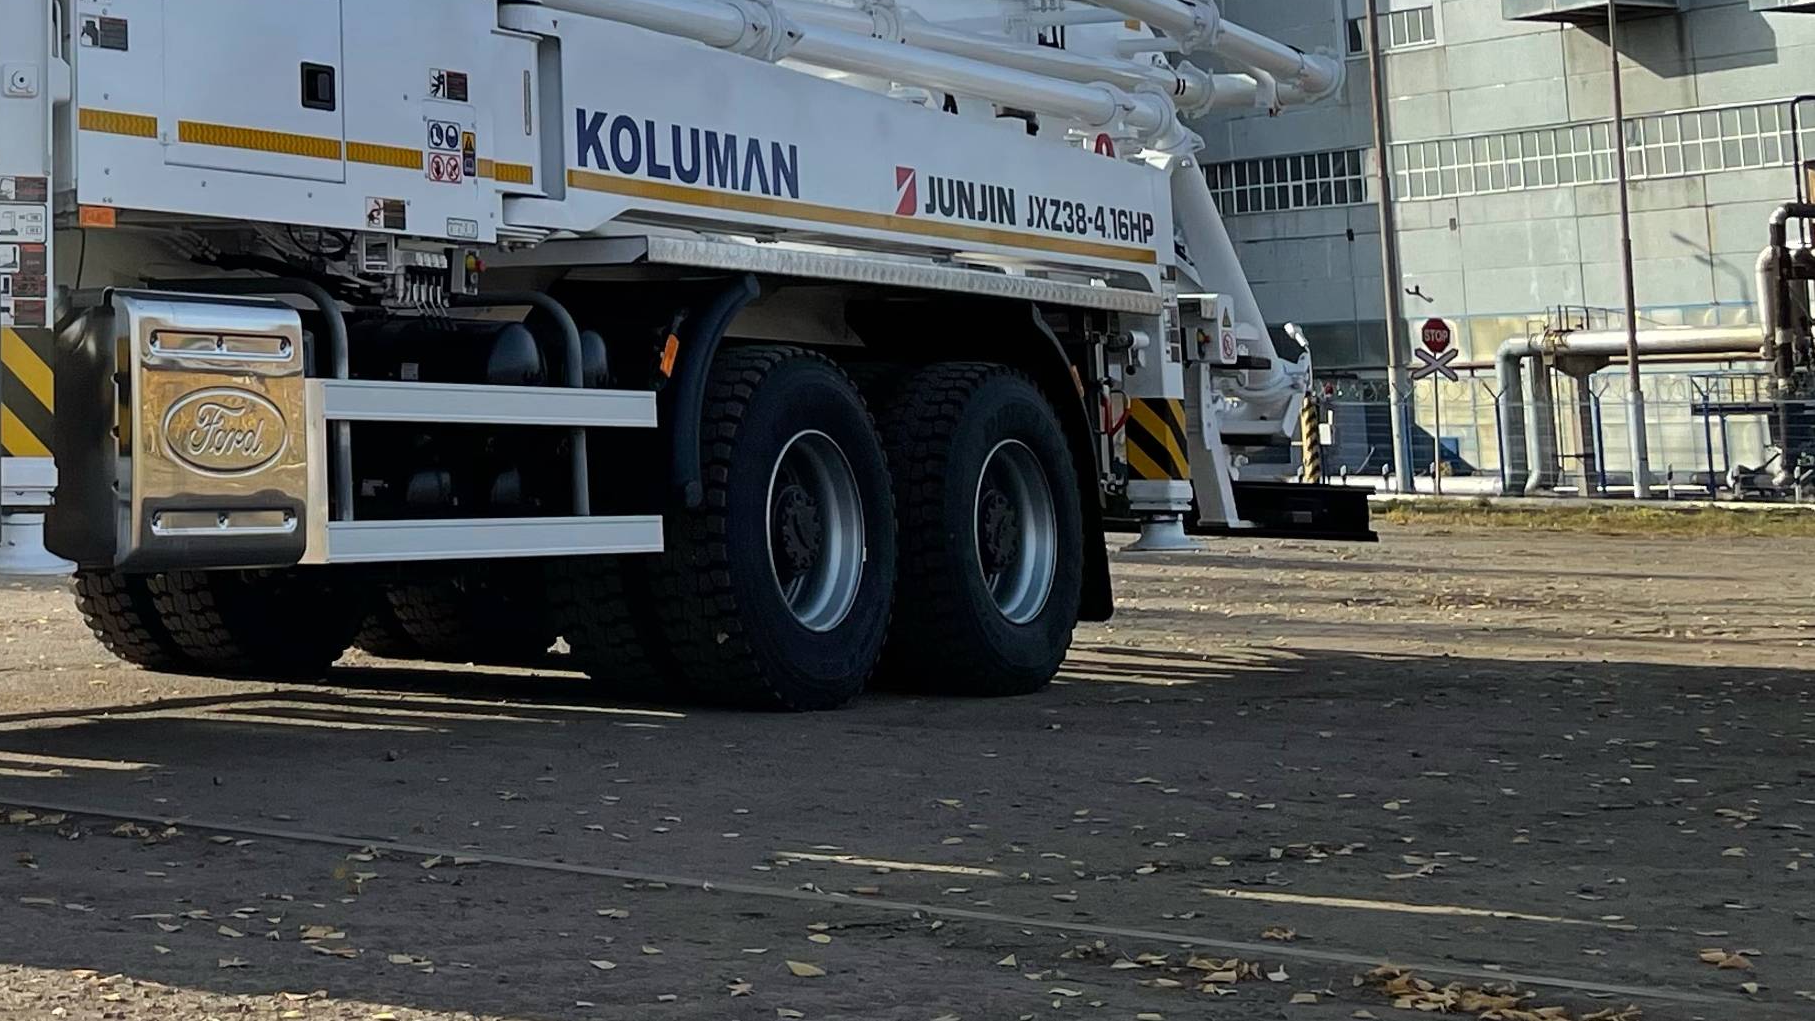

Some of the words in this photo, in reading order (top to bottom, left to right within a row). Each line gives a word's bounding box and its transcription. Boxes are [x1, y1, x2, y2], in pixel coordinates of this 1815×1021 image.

[576, 108, 799, 199] KOLUMAN
[925, 175, 1017, 226] JUNJIN
[1027, 195, 1154, 244] JXZ38-4.16HP
[1424, 329, 1448, 342] STOP
[189, 401, 264, 456] Ford
